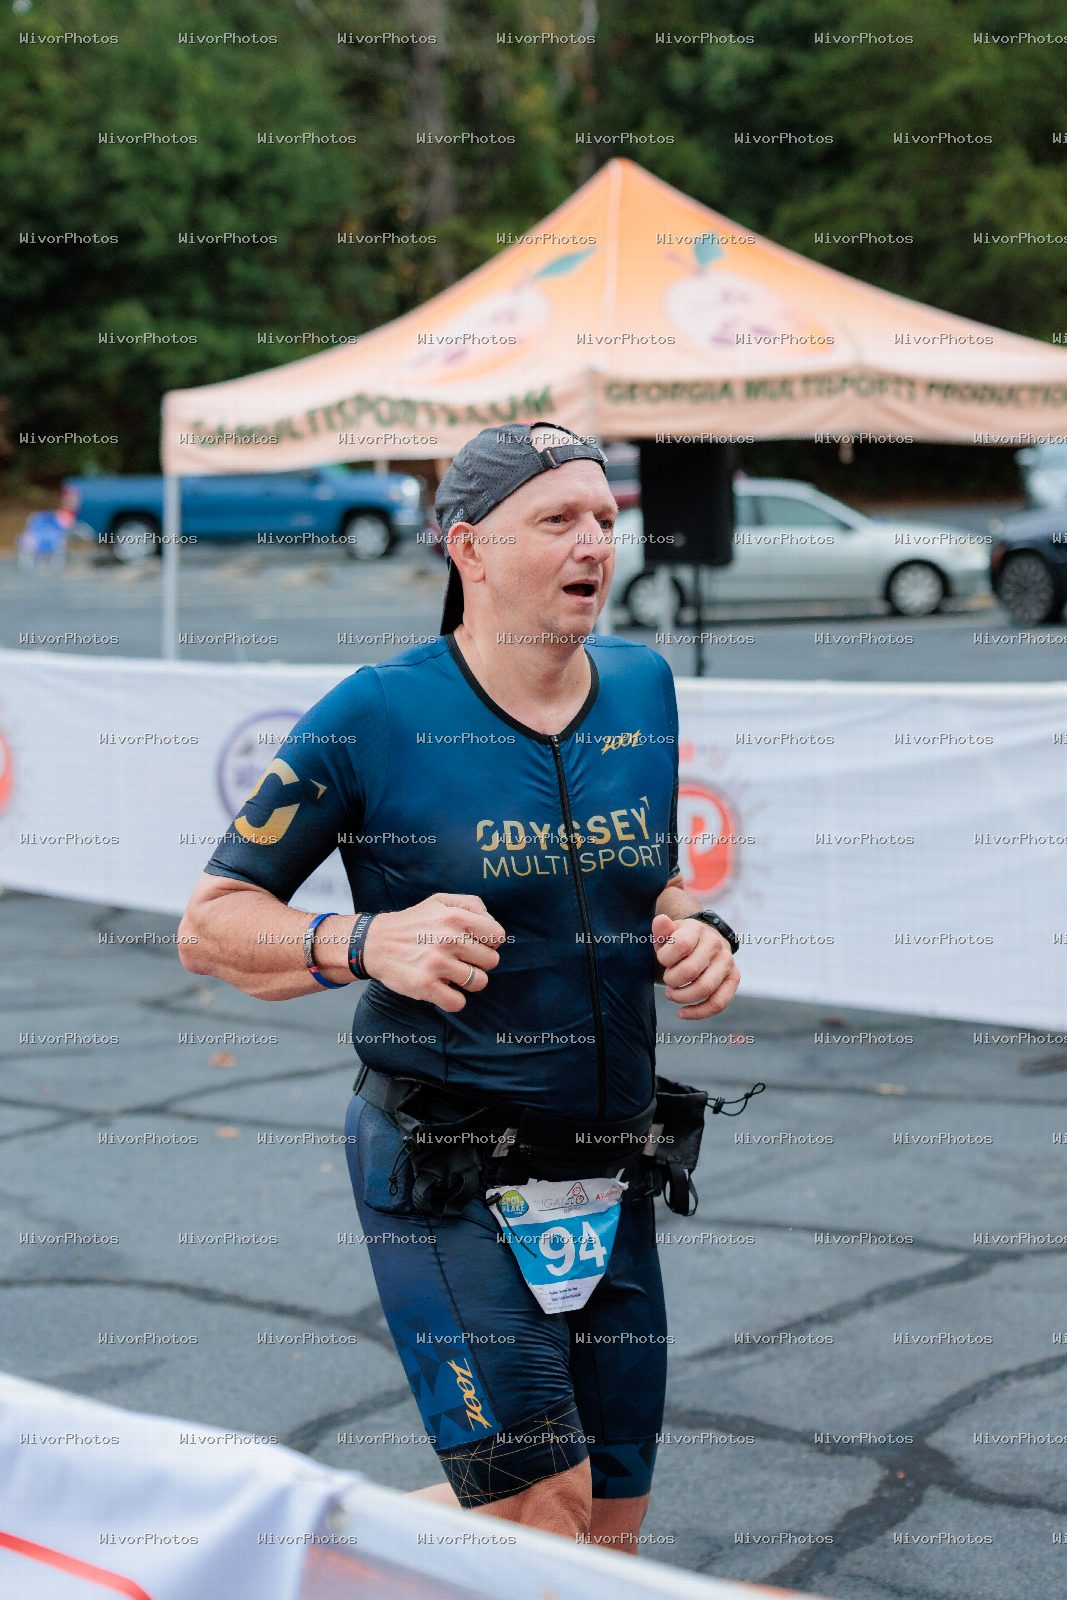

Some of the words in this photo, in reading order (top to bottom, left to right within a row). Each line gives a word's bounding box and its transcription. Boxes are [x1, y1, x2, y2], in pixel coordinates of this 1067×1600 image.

[606, 380, 732, 405] GEORGIA
[743, 373, 915, 400] MULTISPORTS
[477, 796, 650, 851] ODYSSEY
[539, 1221, 607, 1277] 94
